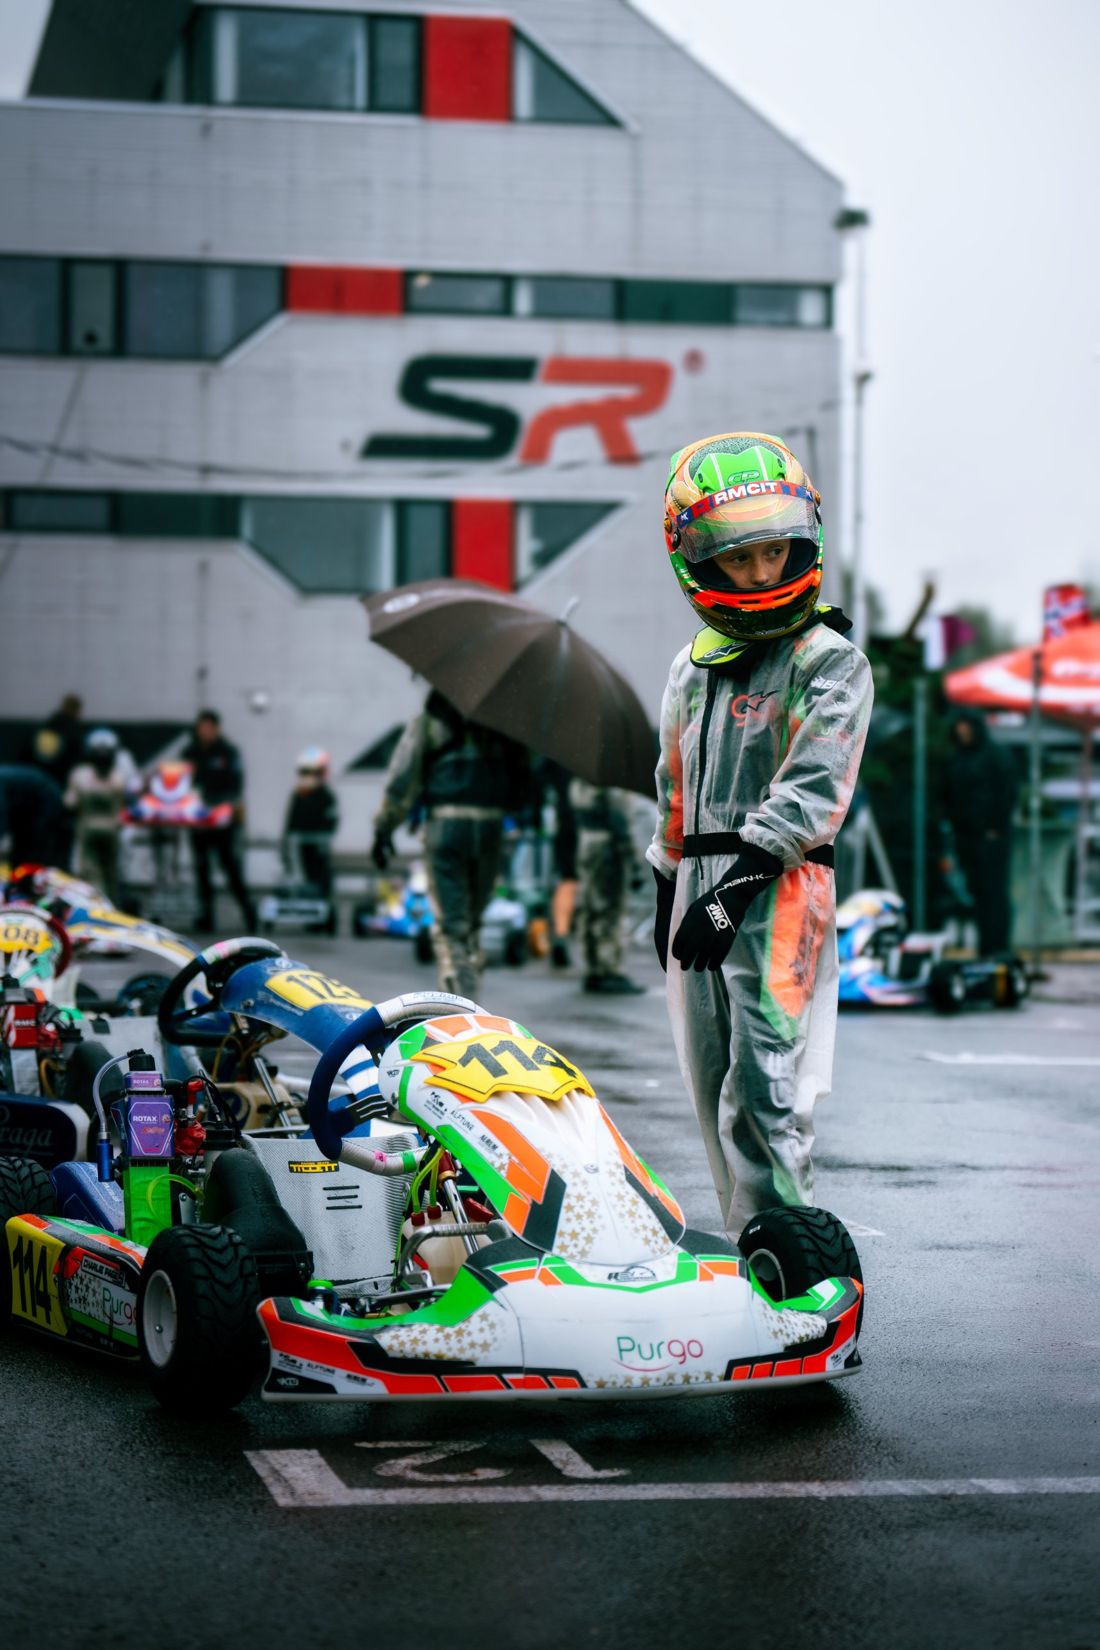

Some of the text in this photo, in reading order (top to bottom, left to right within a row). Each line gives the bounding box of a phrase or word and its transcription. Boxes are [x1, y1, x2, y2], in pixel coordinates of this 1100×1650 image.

[359, 354, 674, 464] SR
[714, 481, 778, 505] RMCIT
[707, 902, 729, 930] OMP
[457, 1039, 579, 1079] 114
[12, 1234, 53, 1325] 114
[617, 1336, 704, 1365] Purgo
